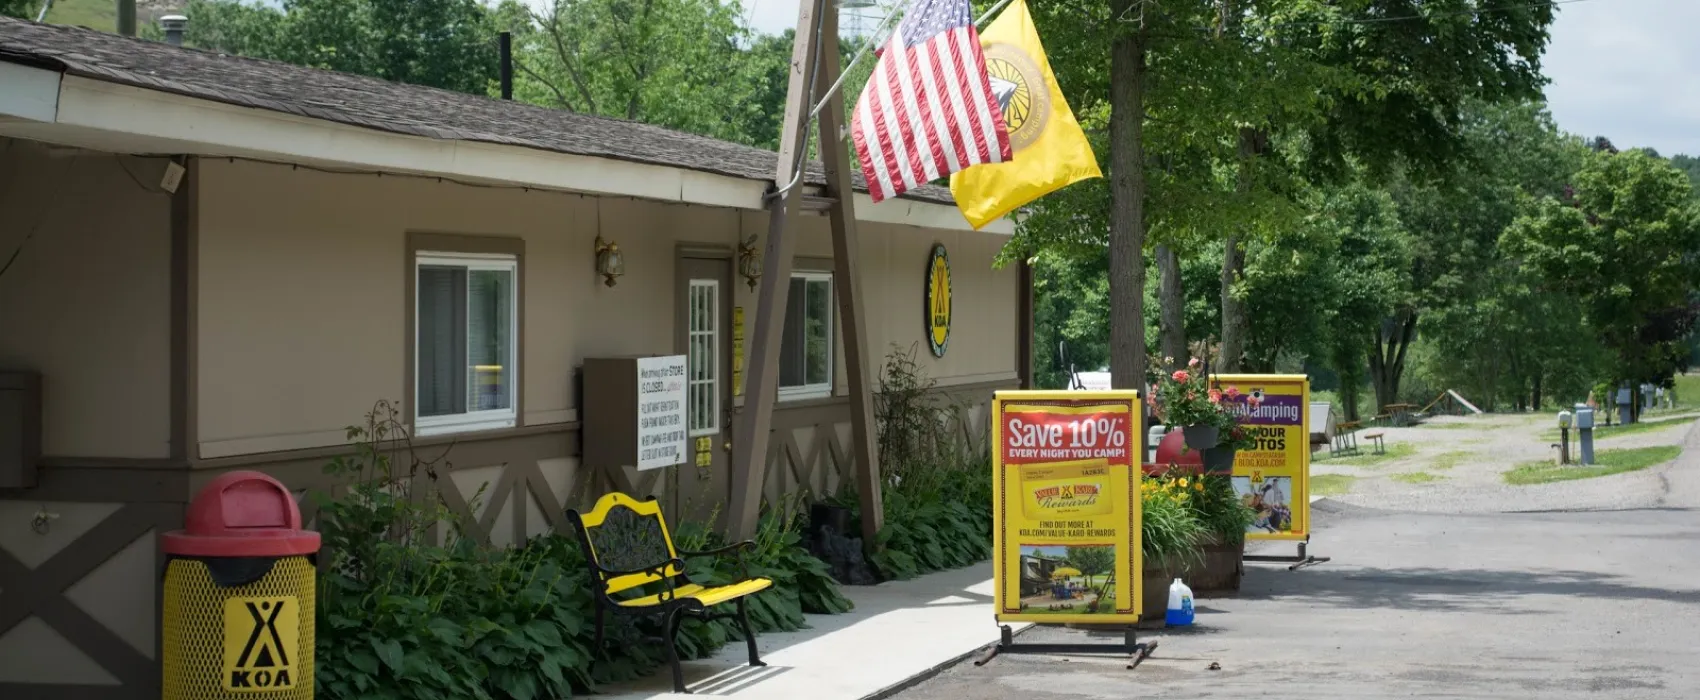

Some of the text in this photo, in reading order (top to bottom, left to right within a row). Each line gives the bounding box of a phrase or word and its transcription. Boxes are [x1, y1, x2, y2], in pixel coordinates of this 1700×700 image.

[934, 315, 947, 327] KOA
[669, 365, 683, 376] STORE
[1009, 418, 1063, 447] Save
[1256, 428, 1285, 438] OUR
[1009, 448, 1125, 458] EVERY NIGHT YOU CAMP!
[1038, 495, 1096, 508] Rewards
[1020, 528, 1115, 537] KOA.COM/VALUE-KARD-REWARDS
[231, 670, 291, 687] KOA
